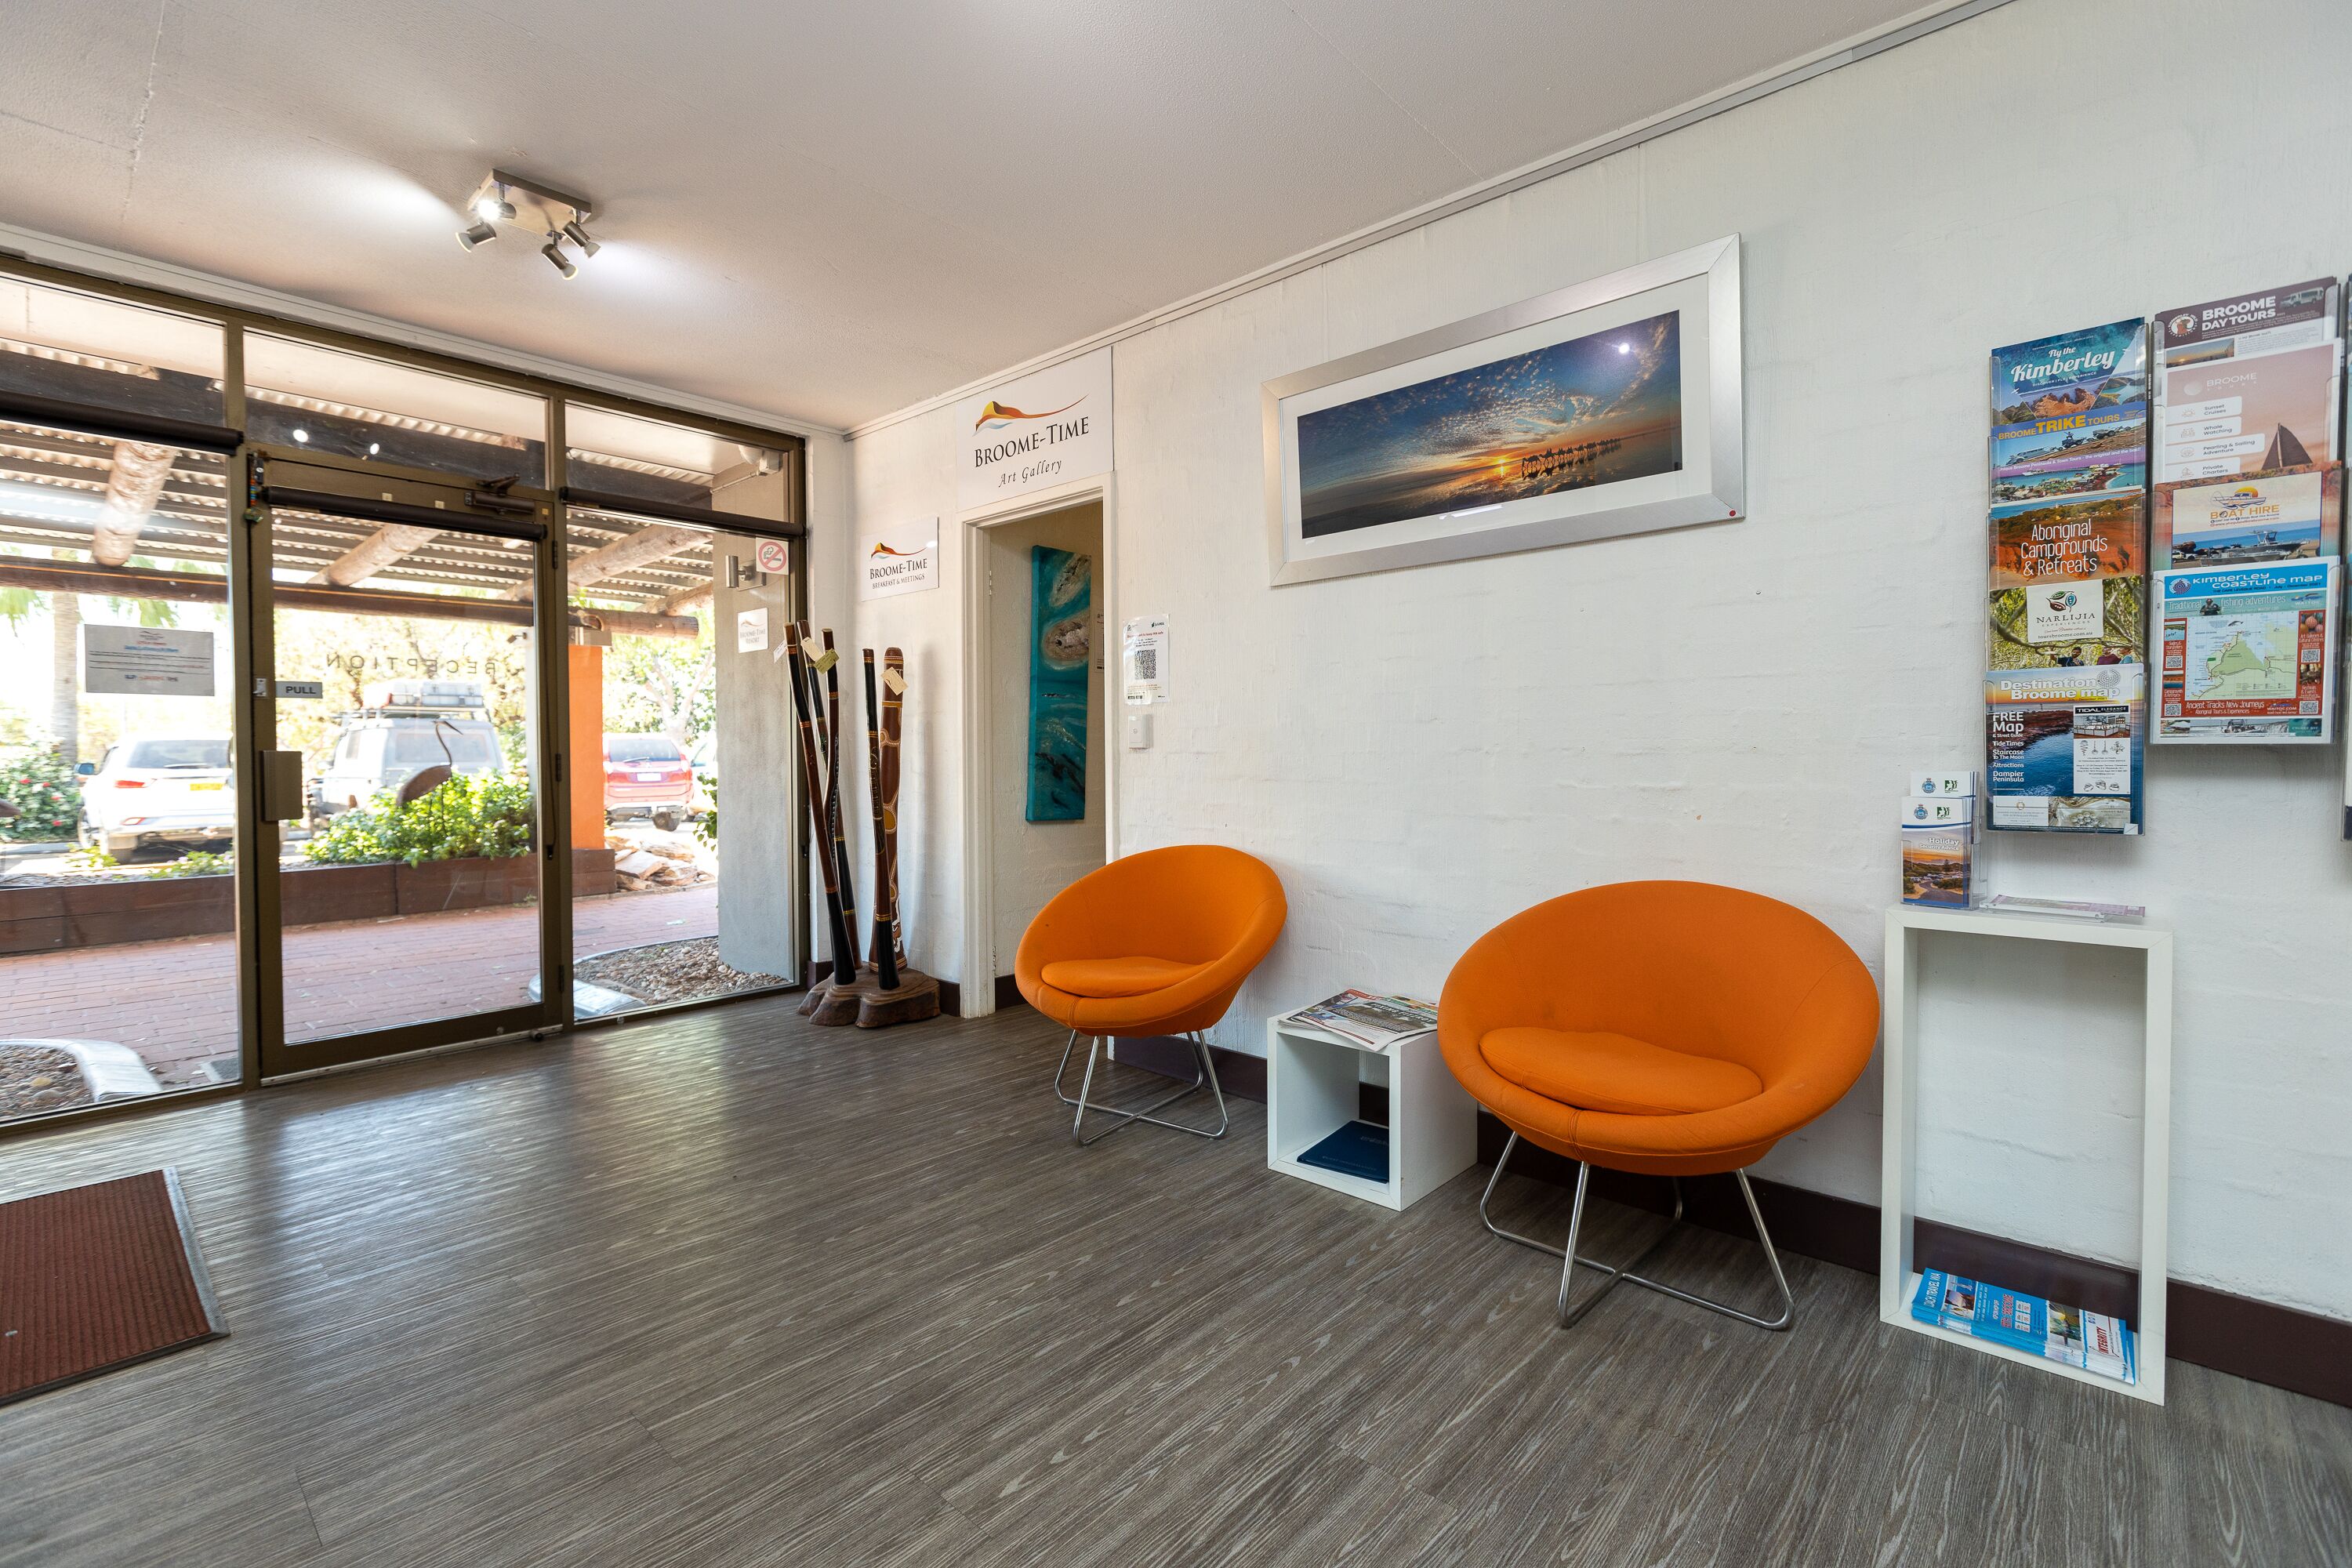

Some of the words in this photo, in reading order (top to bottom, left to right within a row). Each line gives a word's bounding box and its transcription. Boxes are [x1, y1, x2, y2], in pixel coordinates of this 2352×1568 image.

[2202, 296, 2276, 321] BROOME
[2201, 318, 2227, 332] DAY
[2229, 309, 2276, 327] TOURS
[2049, 349, 2062, 358] Fly
[2063, 347, 2076, 355] the
[2010, 351, 2115, 383] Kimberley
[2206, 372, 2257, 387] BROOME
[1998, 427, 2036, 440] BROOME
[2036, 415, 2086, 434] TRIKE
[2088, 414, 2119, 426] TOURS
[2203, 427, 2232, 436] Watching
[975, 416, 1089, 467] BROOME-TIME
[998, 471, 1016, 488] Art
[1022, 459, 1062, 484] Gallery
[2210, 509, 2245, 520] BOAT
[2249, 504, 2280, 516] HIRE
[2031, 518, 2092, 541] Aboriginal
[2020, 535, 2108, 559] Campgrounds
[869, 558, 927, 579] BROOME-TIME
[2023, 561, 2034, 576] &
[2038, 555, 2097, 576] Retreats
[872, 579, 895, 589] BREAKFAST
[901, 573, 925, 584] MEETINGS
[2290, 575, 2323, 584] map
[2169, 600, 2201, 611] Traditional
[2221, 597, 2243, 607] fishing
[2245, 594, 2286, 605] adventures
[2036, 612, 2095, 623] NARLIJIA
[285, 685, 317, 695] PULL
[2001, 677, 2097, 691] Destination
[2011, 689, 2077, 700] Broome
[2081, 688, 2120, 699] map
[1993, 711, 2024, 721] FREE
[1993, 722, 2024, 734] Map
[2096, 1327, 2109, 1354] INTEGRITY
